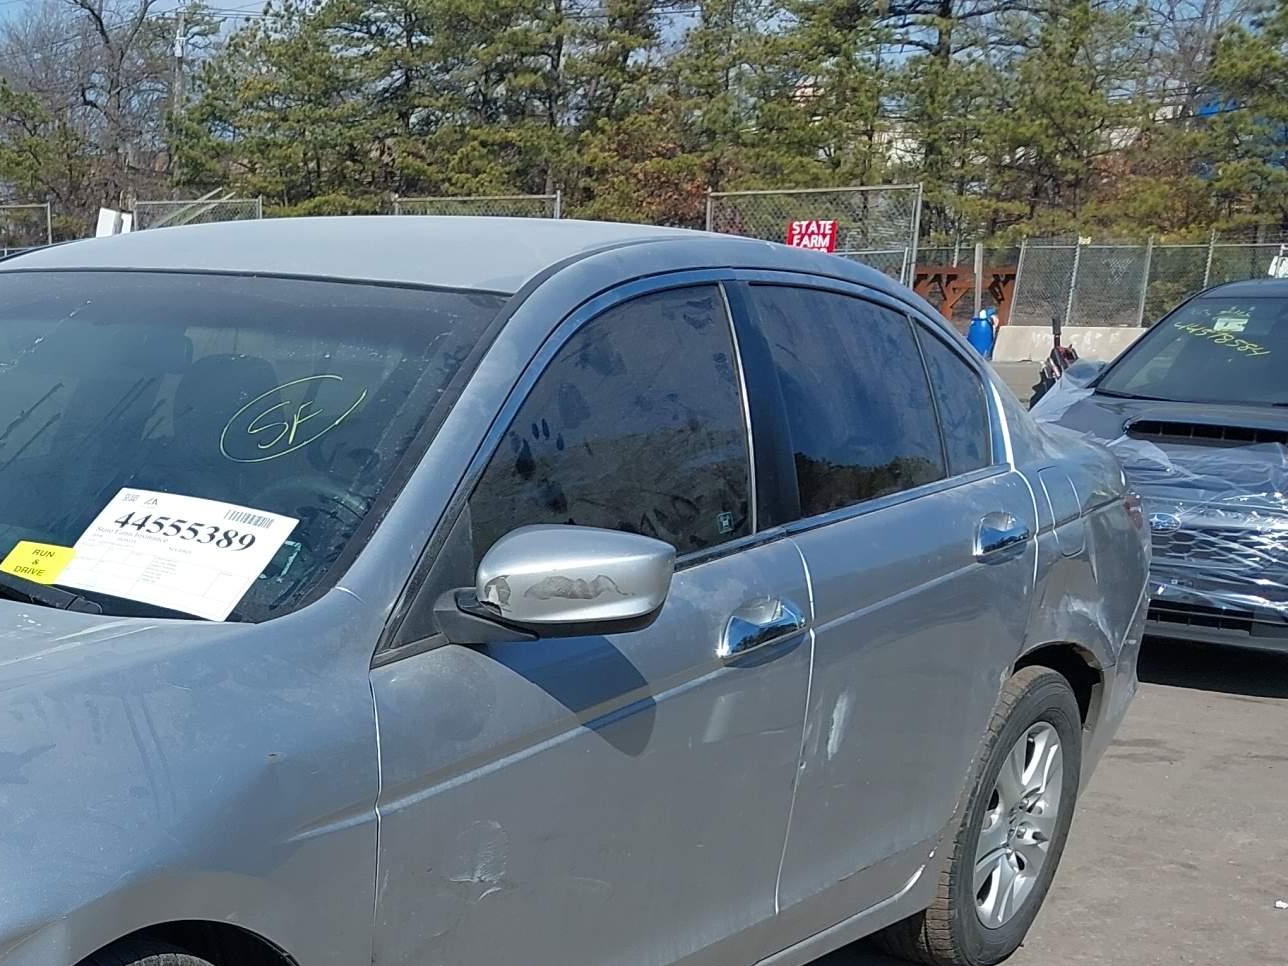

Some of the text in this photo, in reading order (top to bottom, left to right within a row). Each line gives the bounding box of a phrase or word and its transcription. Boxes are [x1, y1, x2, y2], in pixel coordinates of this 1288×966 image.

[792, 220, 833, 234] STATE
[792, 235, 830, 248] FARM
[248, 400, 323, 448] SF
[114, 512, 256, 551] 44555389
[32, 549, 55, 557] RUN
[13, 565, 46, 577] DRIVE
